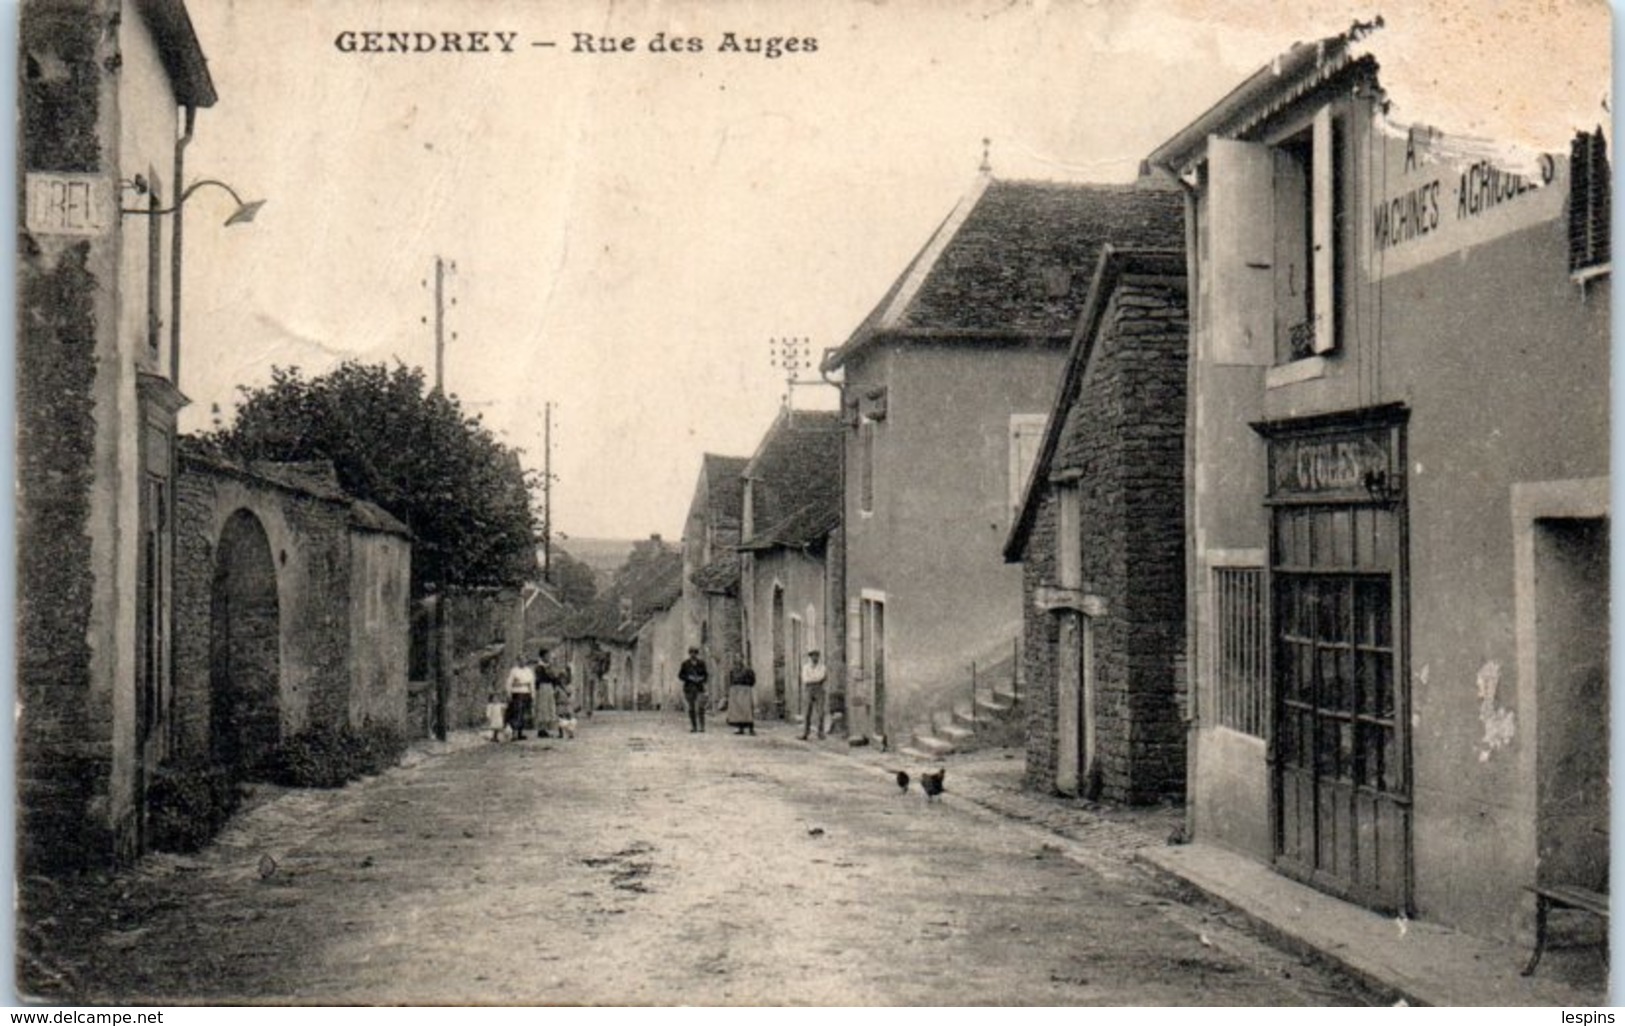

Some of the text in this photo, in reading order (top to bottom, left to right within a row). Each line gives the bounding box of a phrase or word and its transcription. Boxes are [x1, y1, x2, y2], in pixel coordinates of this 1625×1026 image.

[1373, 153, 1555, 250] MACHINES AGRICOLS
[1297, 442, 1360, 491] CYCLES
